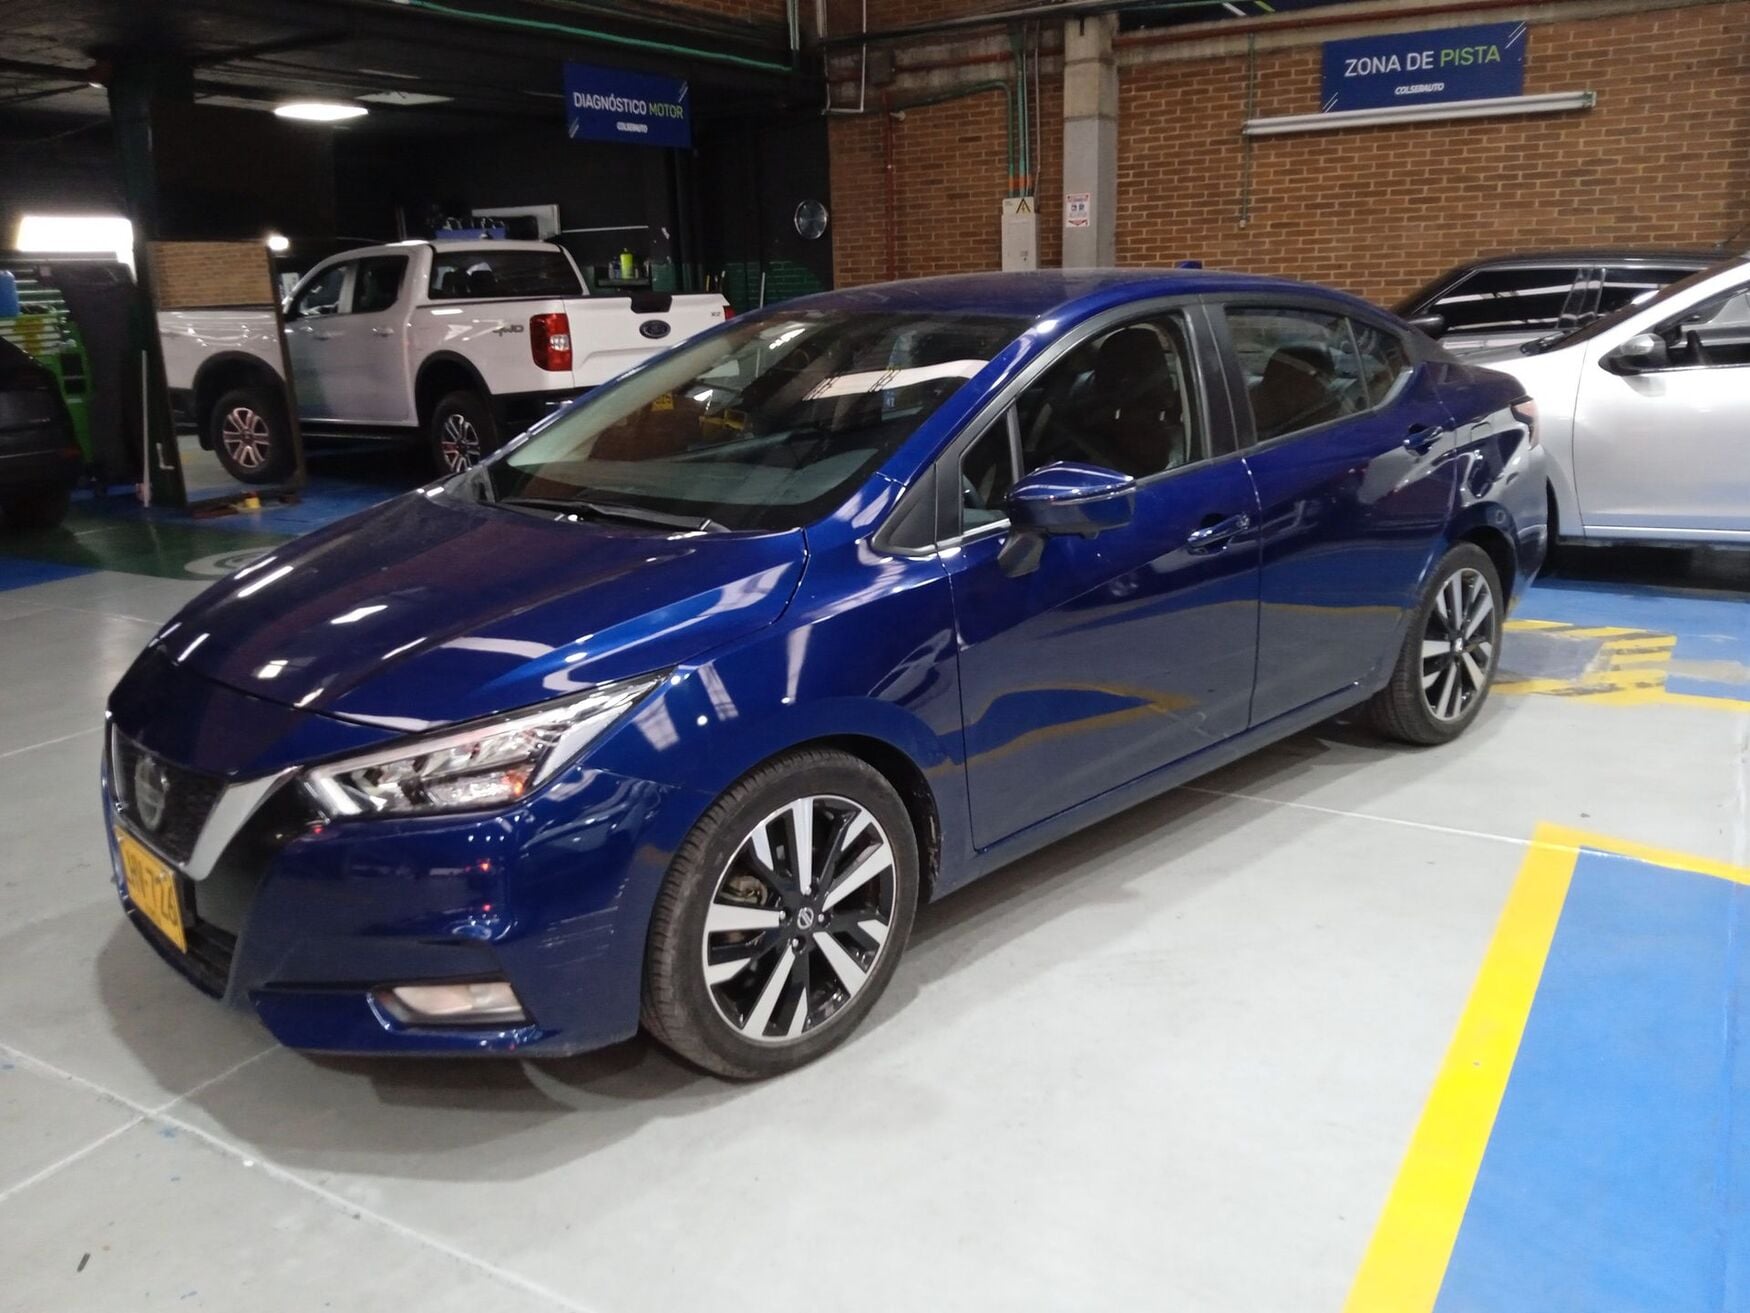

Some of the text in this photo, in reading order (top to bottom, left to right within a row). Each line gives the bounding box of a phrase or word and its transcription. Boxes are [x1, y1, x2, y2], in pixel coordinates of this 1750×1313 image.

[1344, 45, 1501, 77] ZONA DE PISTA
[573, 91, 684, 119] DIAGNÓSTICO MOTOR
